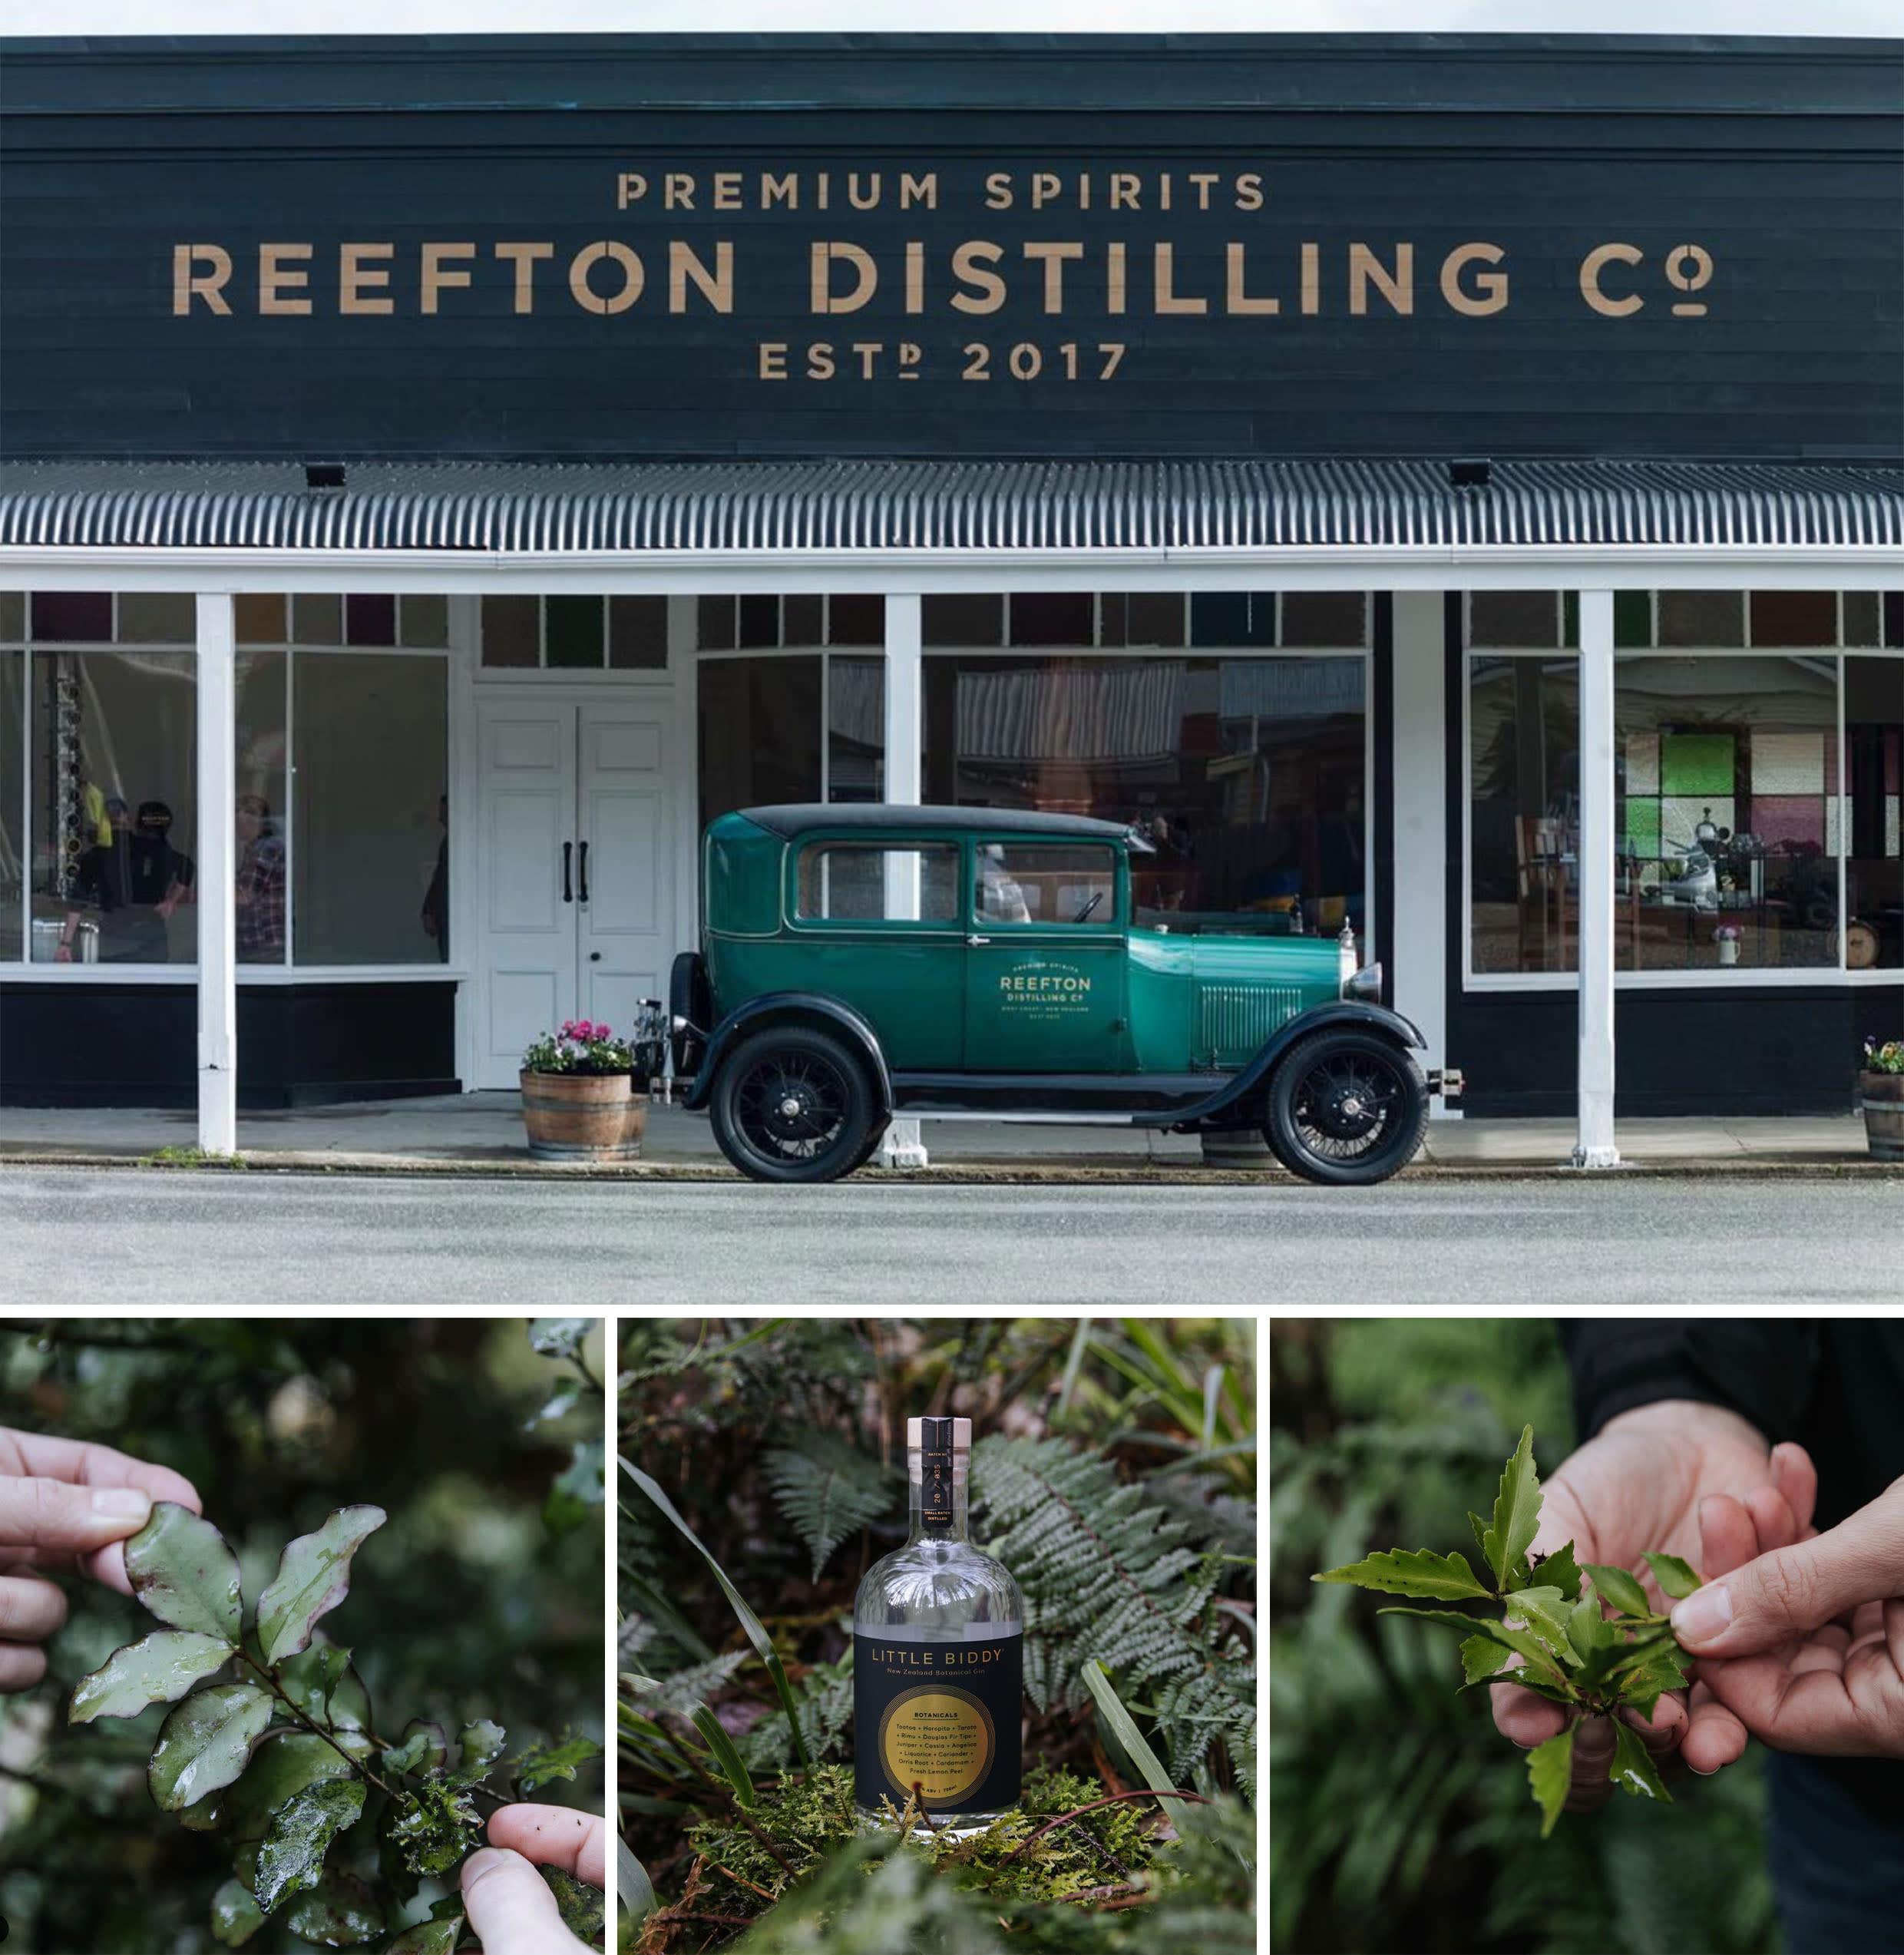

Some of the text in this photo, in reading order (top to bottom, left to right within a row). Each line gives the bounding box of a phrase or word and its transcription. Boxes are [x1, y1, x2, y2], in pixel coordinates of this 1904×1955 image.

[619, 173, 1264, 210] PREMIUM SPIRITS
[173, 241, 733, 315] REEFTON
[811, 241, 1509, 316] DISTILLING
[962, 343, 1125, 379] 2017
[1000, 977, 1091, 991] REEFTON
[1007, 994, 1066, 1002] DISTILLING
[872, 1648, 1001, 1665] LITTLE BIDDY
